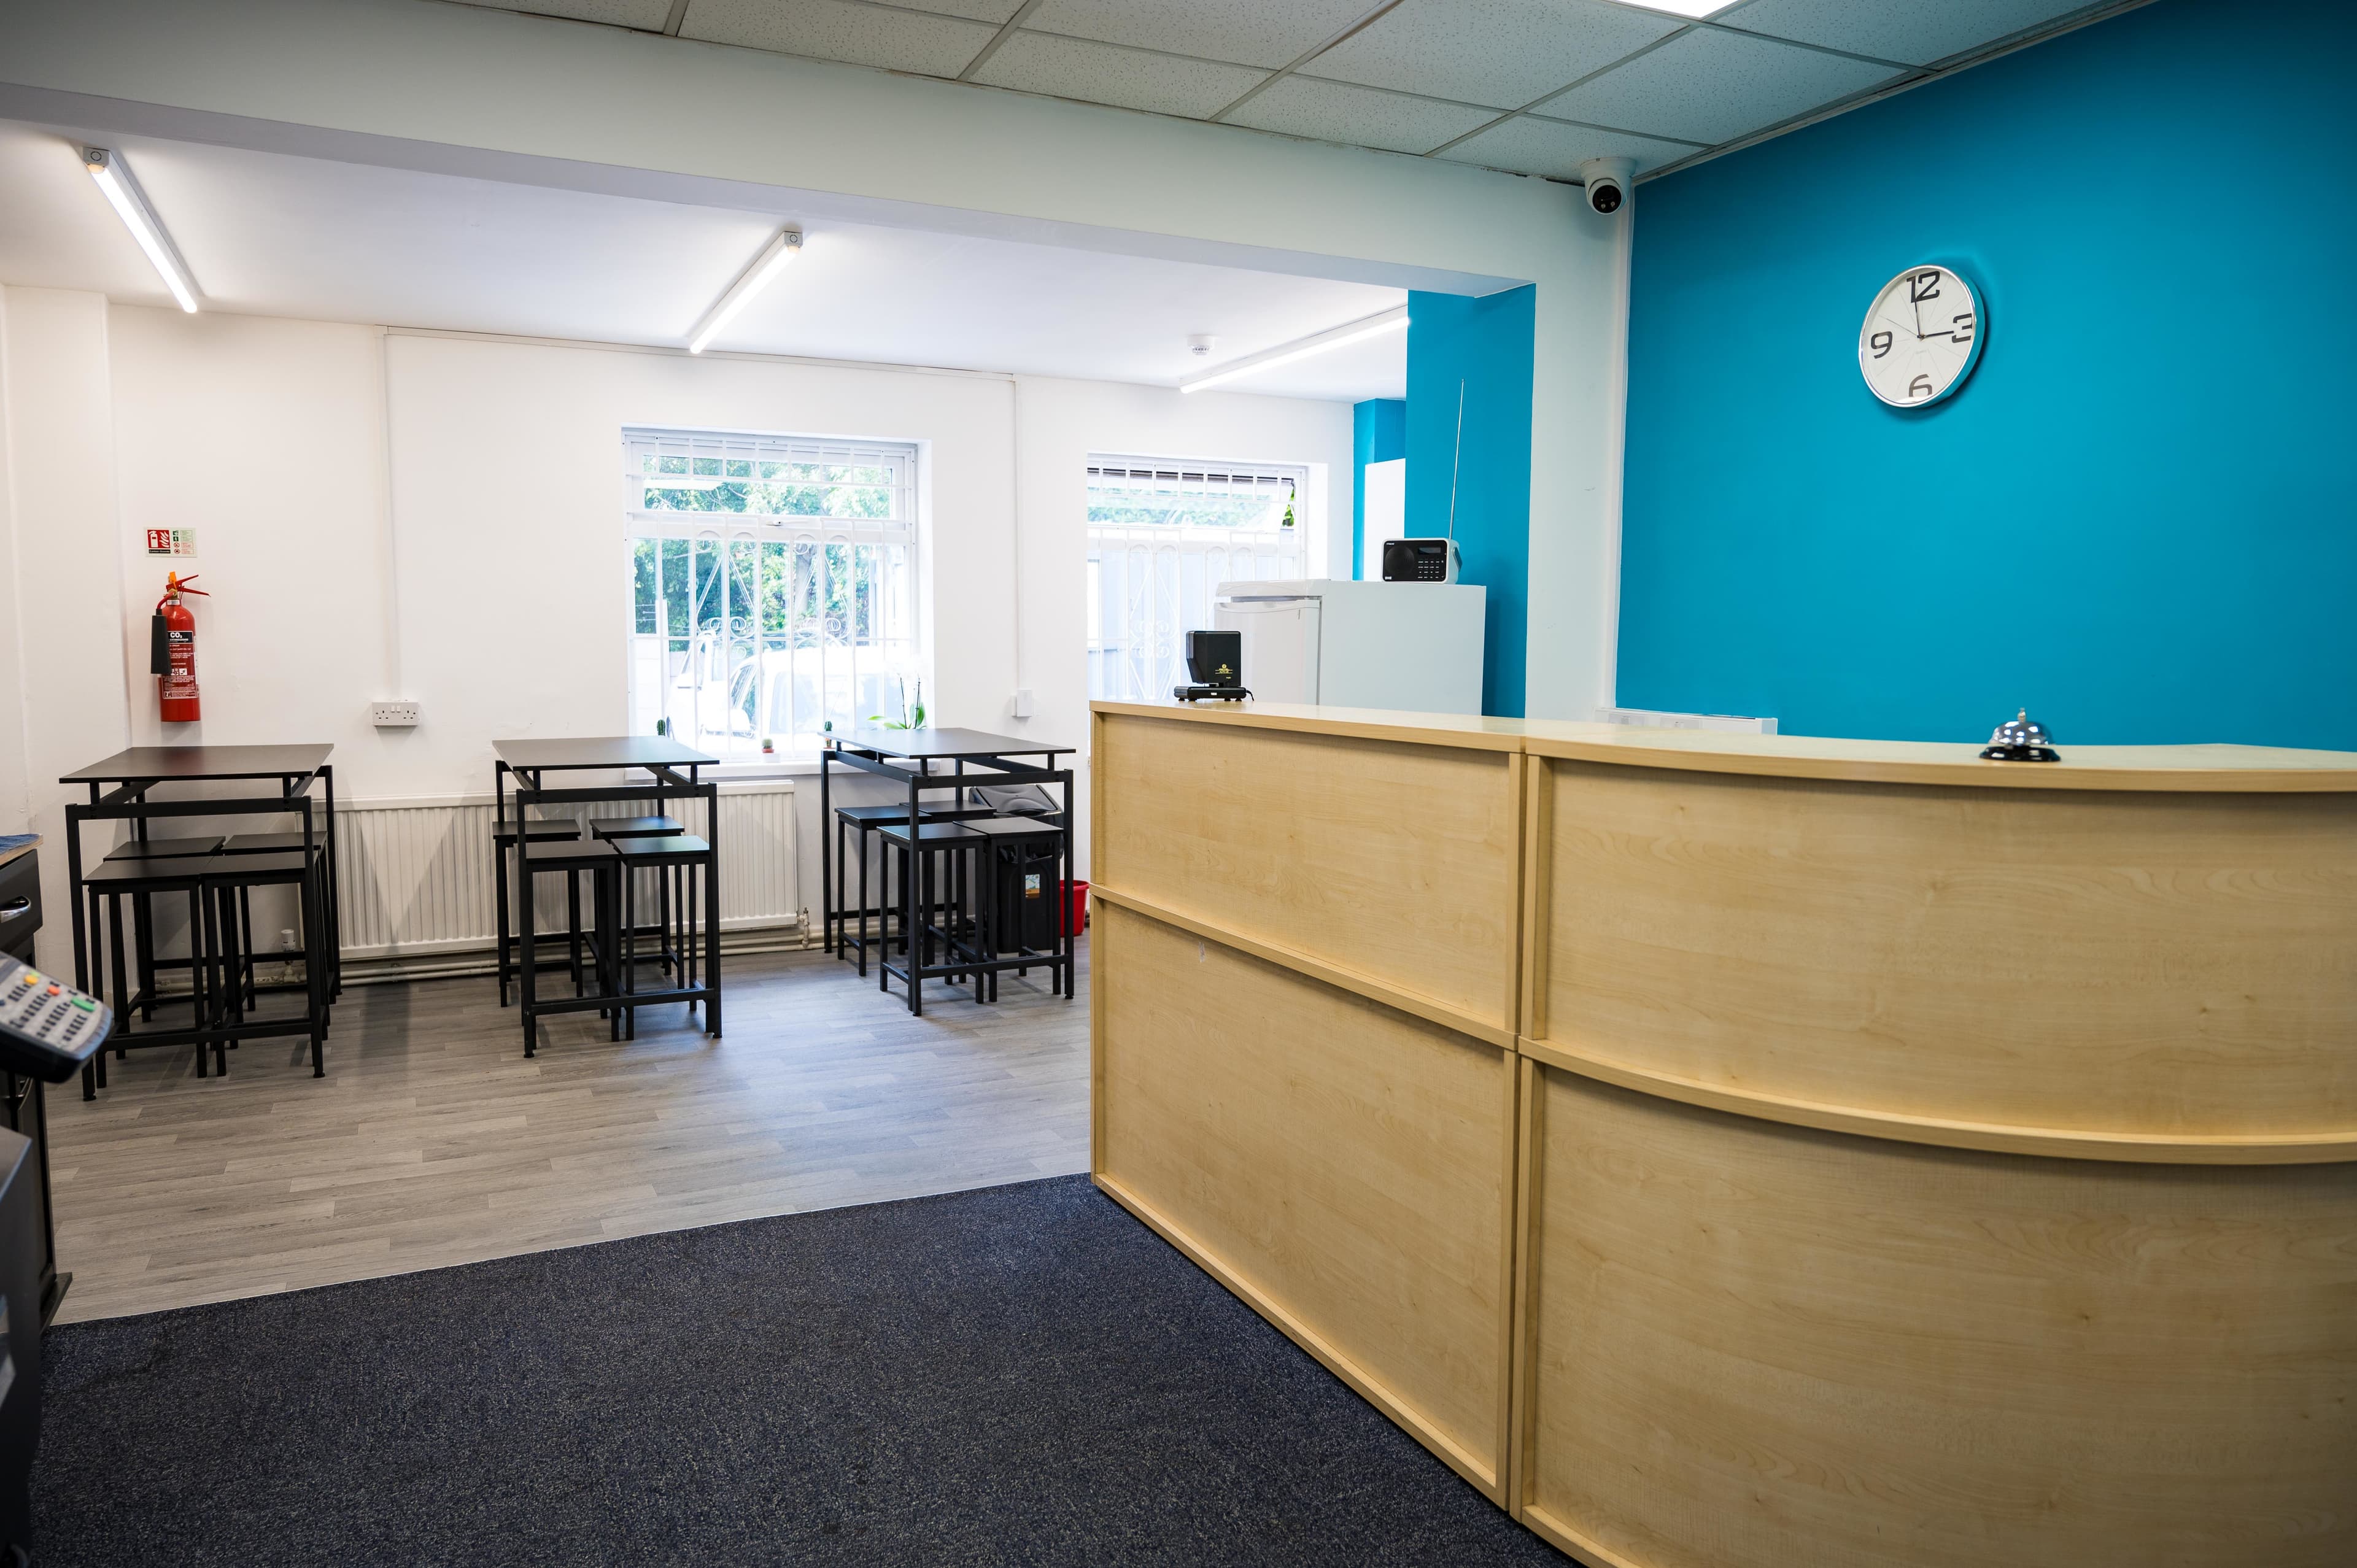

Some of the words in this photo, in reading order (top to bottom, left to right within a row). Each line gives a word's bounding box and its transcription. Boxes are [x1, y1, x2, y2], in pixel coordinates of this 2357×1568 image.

[1906, 271, 1940, 303] 12
[1951, 313, 1972, 344] 3
[1870, 331, 1893, 359] 9
[1908, 374, 1933, 397] 6
